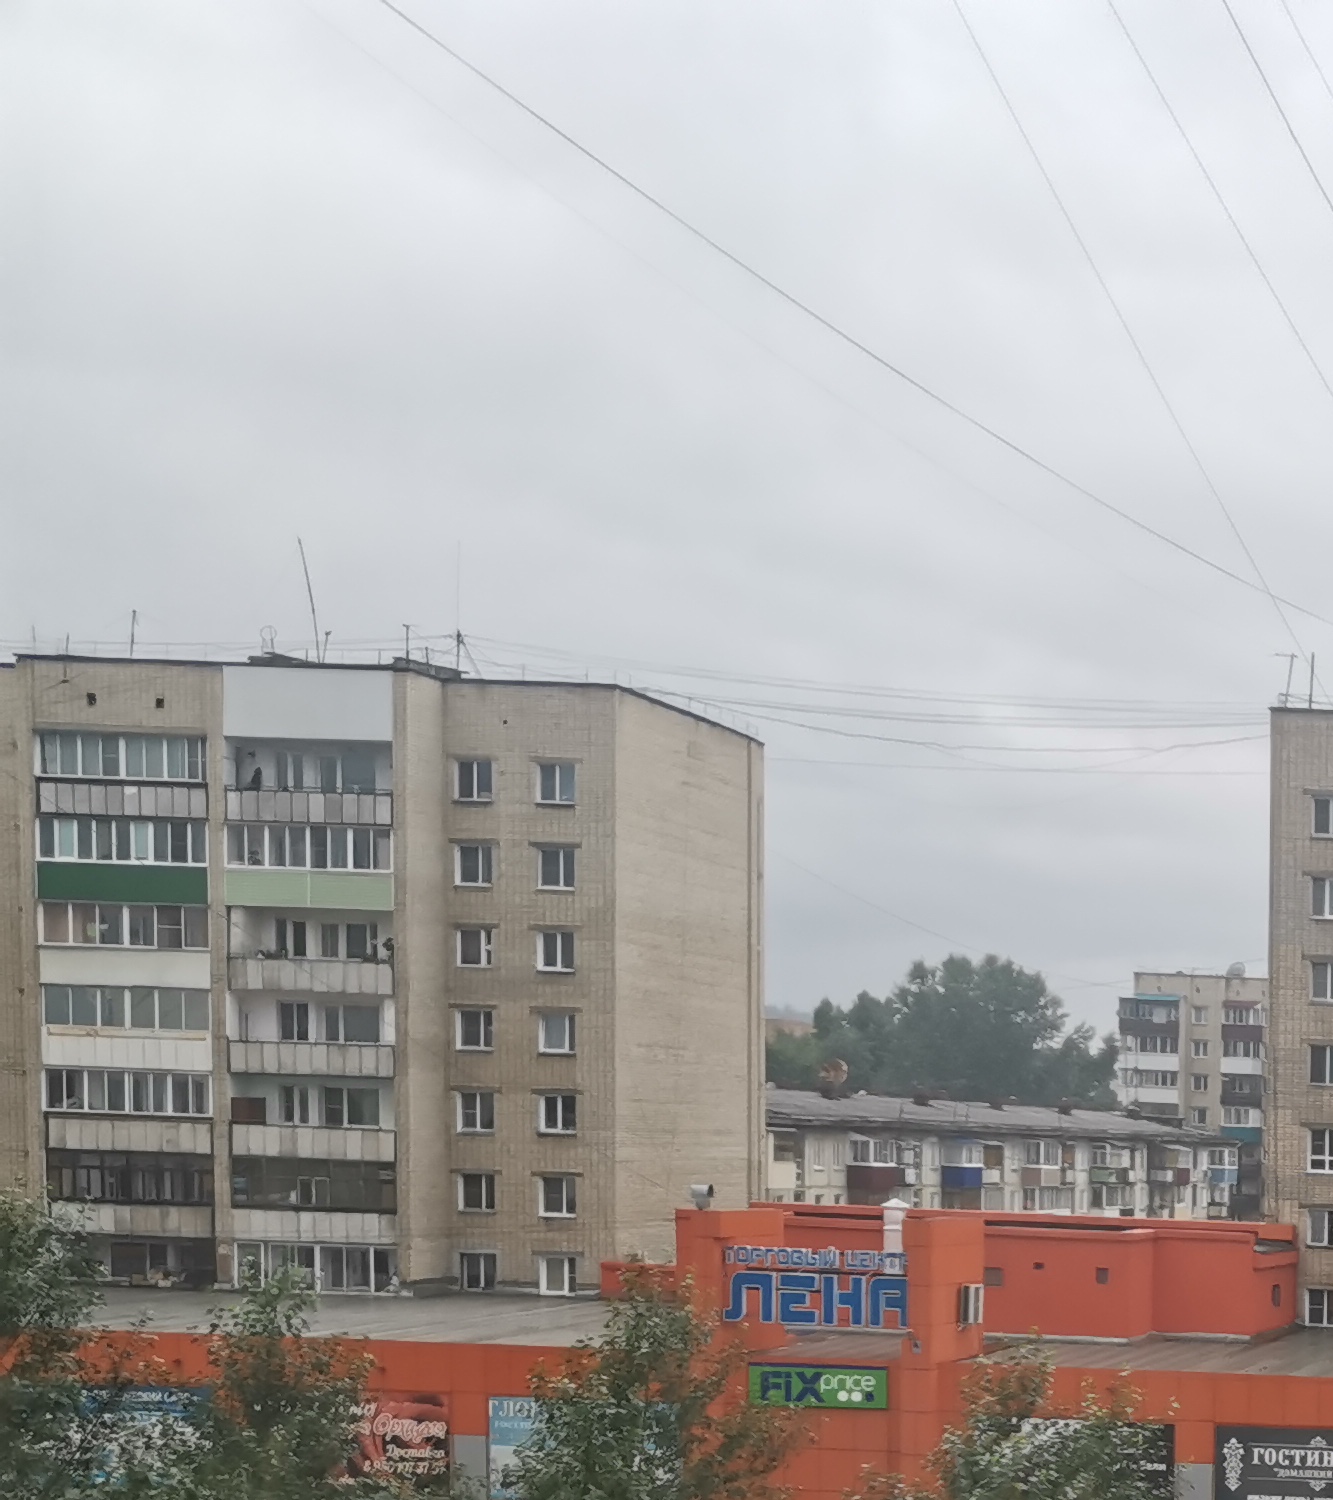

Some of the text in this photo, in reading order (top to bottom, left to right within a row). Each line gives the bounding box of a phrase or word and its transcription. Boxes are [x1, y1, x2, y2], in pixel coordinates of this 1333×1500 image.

[723, 1245, 839, 1268] ТОРГОВЫЙ
[723, 1270, 908, 1328] ЛЕНА
[820, 1374, 877, 1393] price
